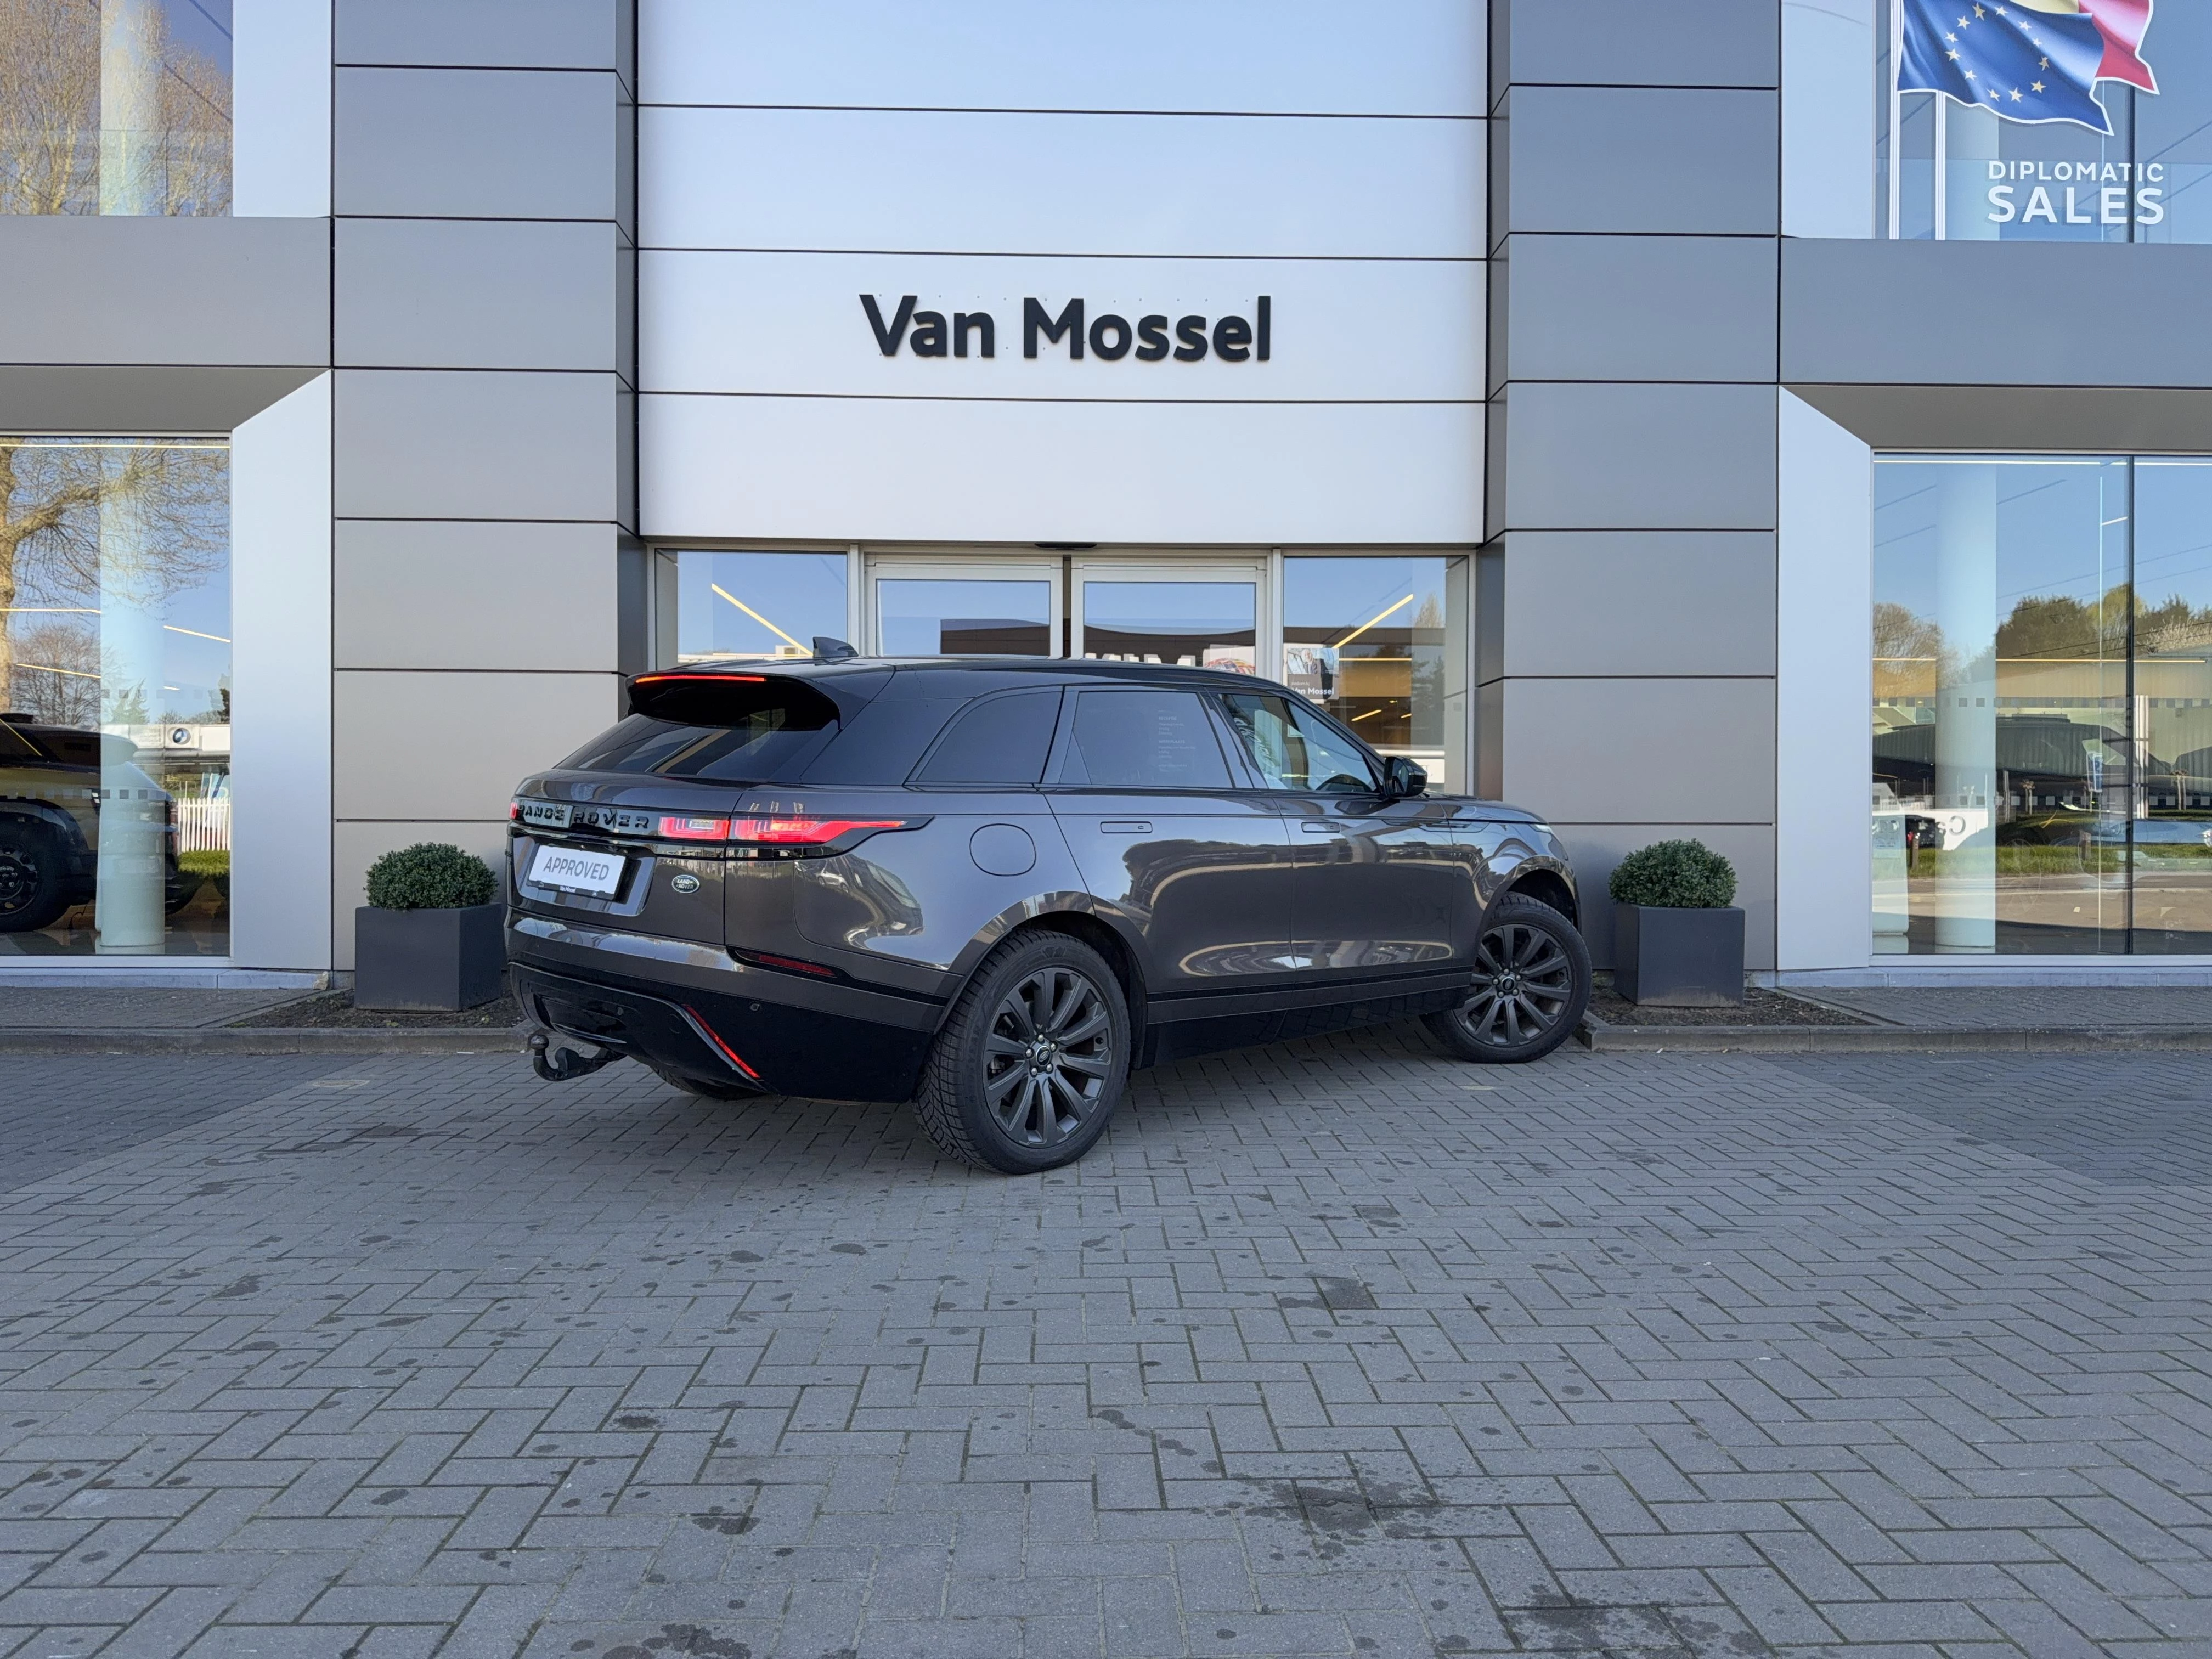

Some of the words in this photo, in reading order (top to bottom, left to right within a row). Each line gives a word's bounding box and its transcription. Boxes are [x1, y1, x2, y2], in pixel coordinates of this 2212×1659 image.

[1988, 161, 2164, 182] DIPLOMATIC
[1988, 185, 2164, 225] SALES
[859, 294, 994, 357] Van
[1024, 296, 1271, 361] Mossel
[1291, 687, 1306, 695] Van
[517, 804, 565, 821] RANGE
[574, 811, 650, 829] ROVER
[543, 856, 610, 881] APPROVED
